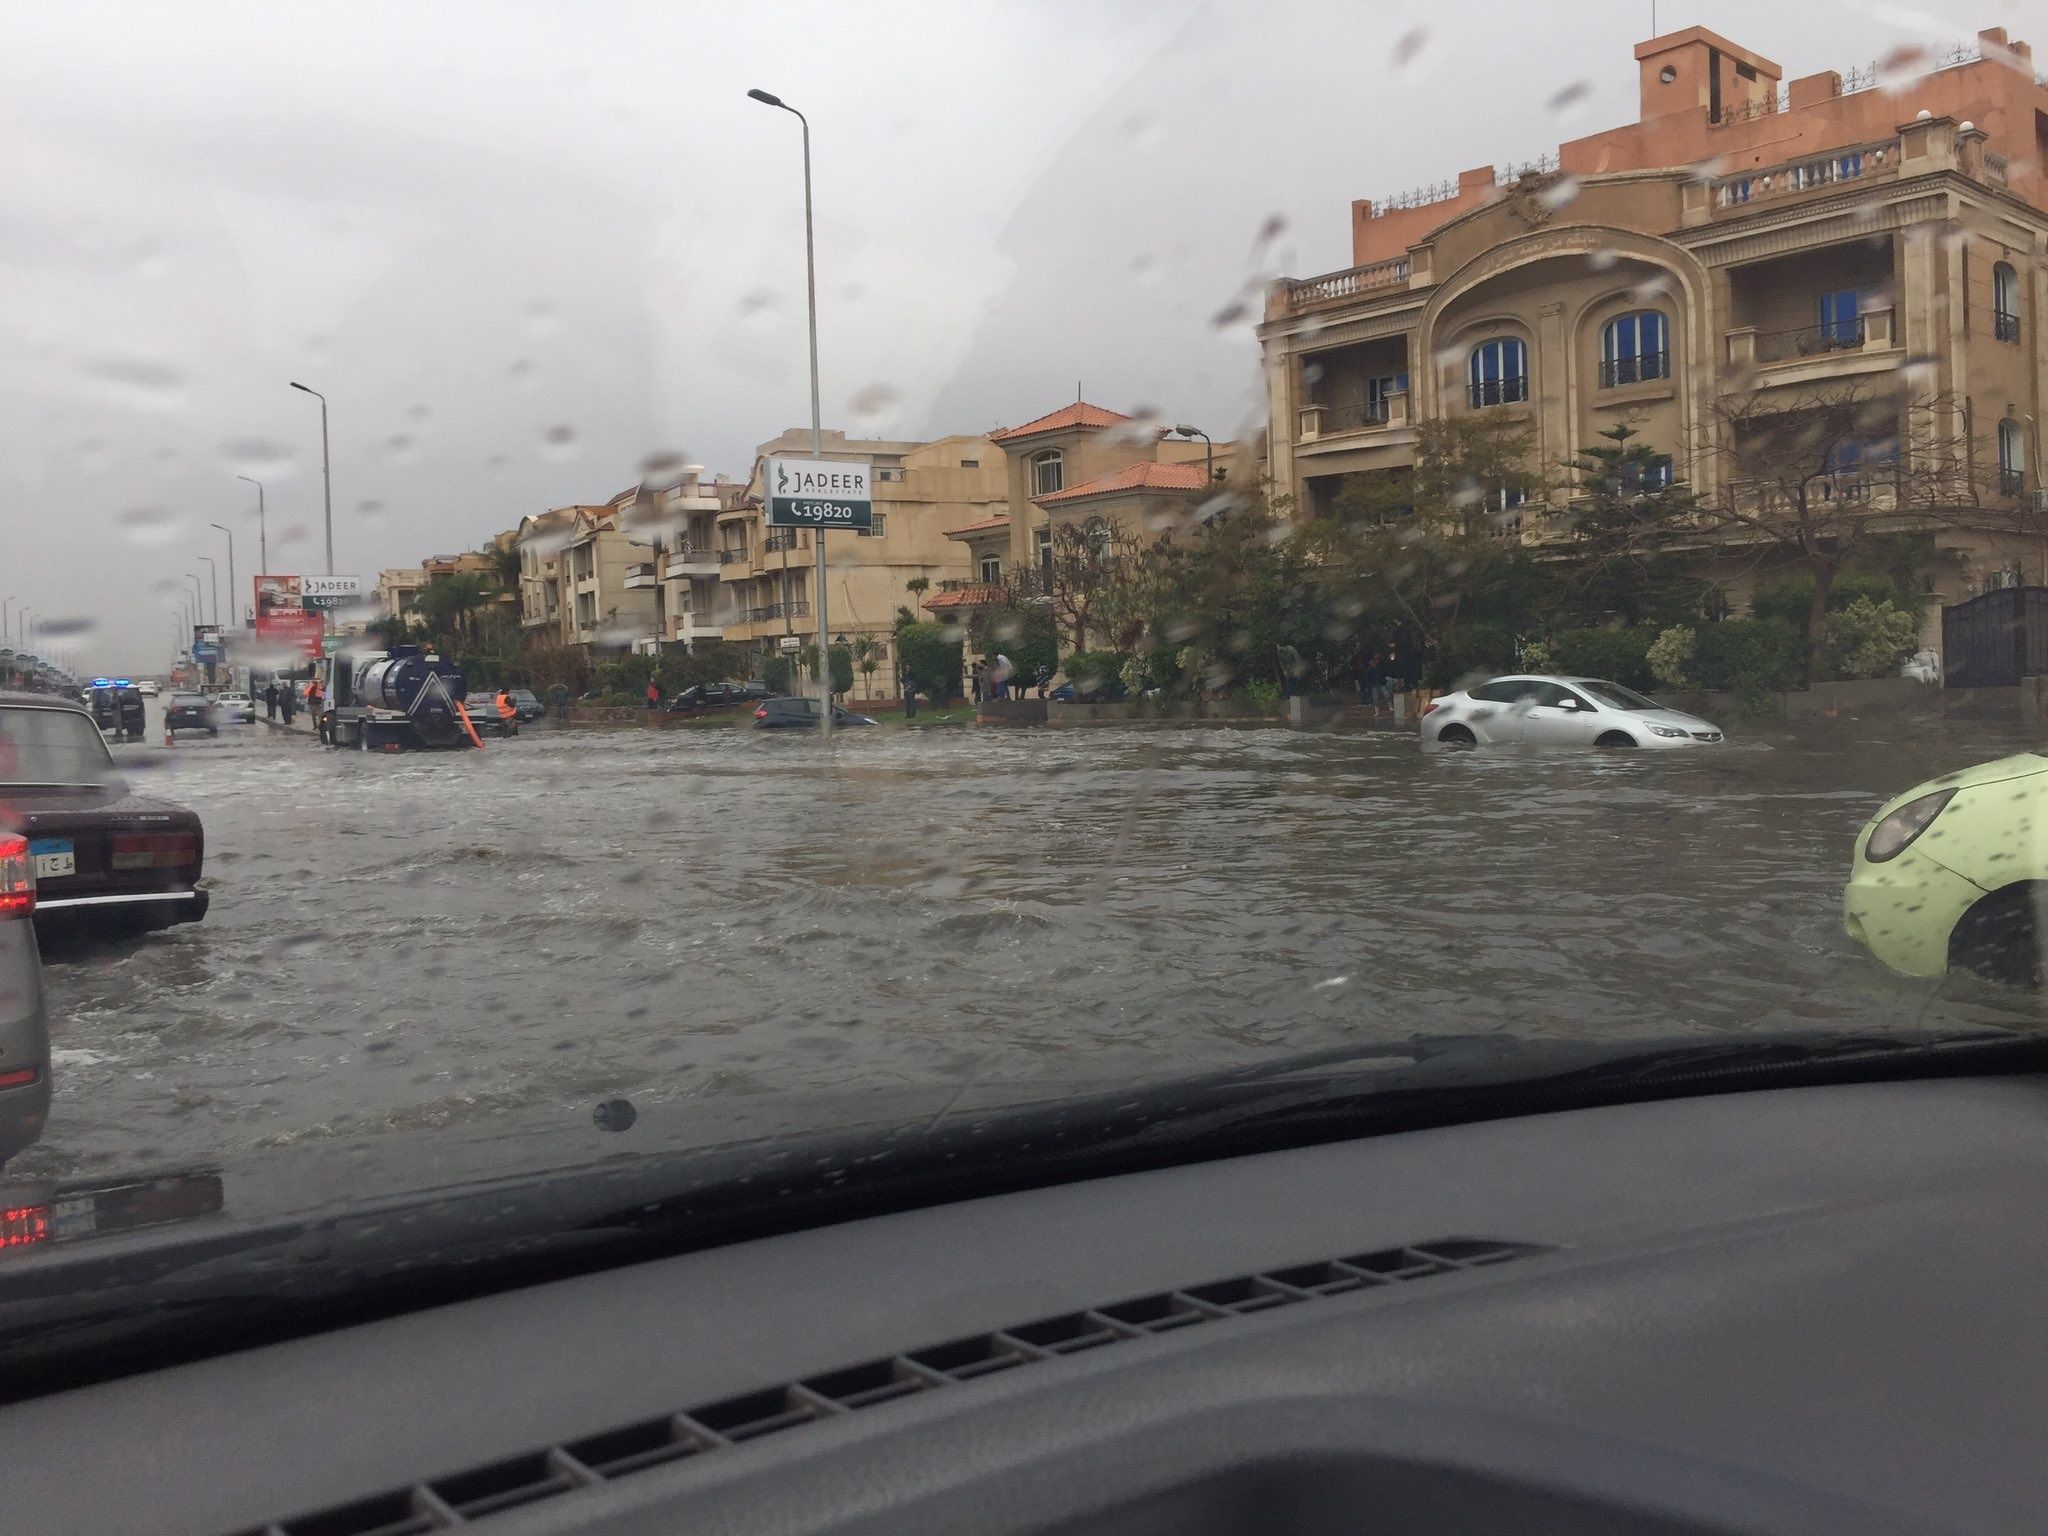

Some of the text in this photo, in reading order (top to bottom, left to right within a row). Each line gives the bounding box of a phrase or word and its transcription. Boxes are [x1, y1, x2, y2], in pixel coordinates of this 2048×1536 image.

[794, 472, 864, 493] JADEER
[803, 502, 852, 521] 19820
[314, 582, 356, 593] JADEER
[320, 597, 343, 607] 1982
